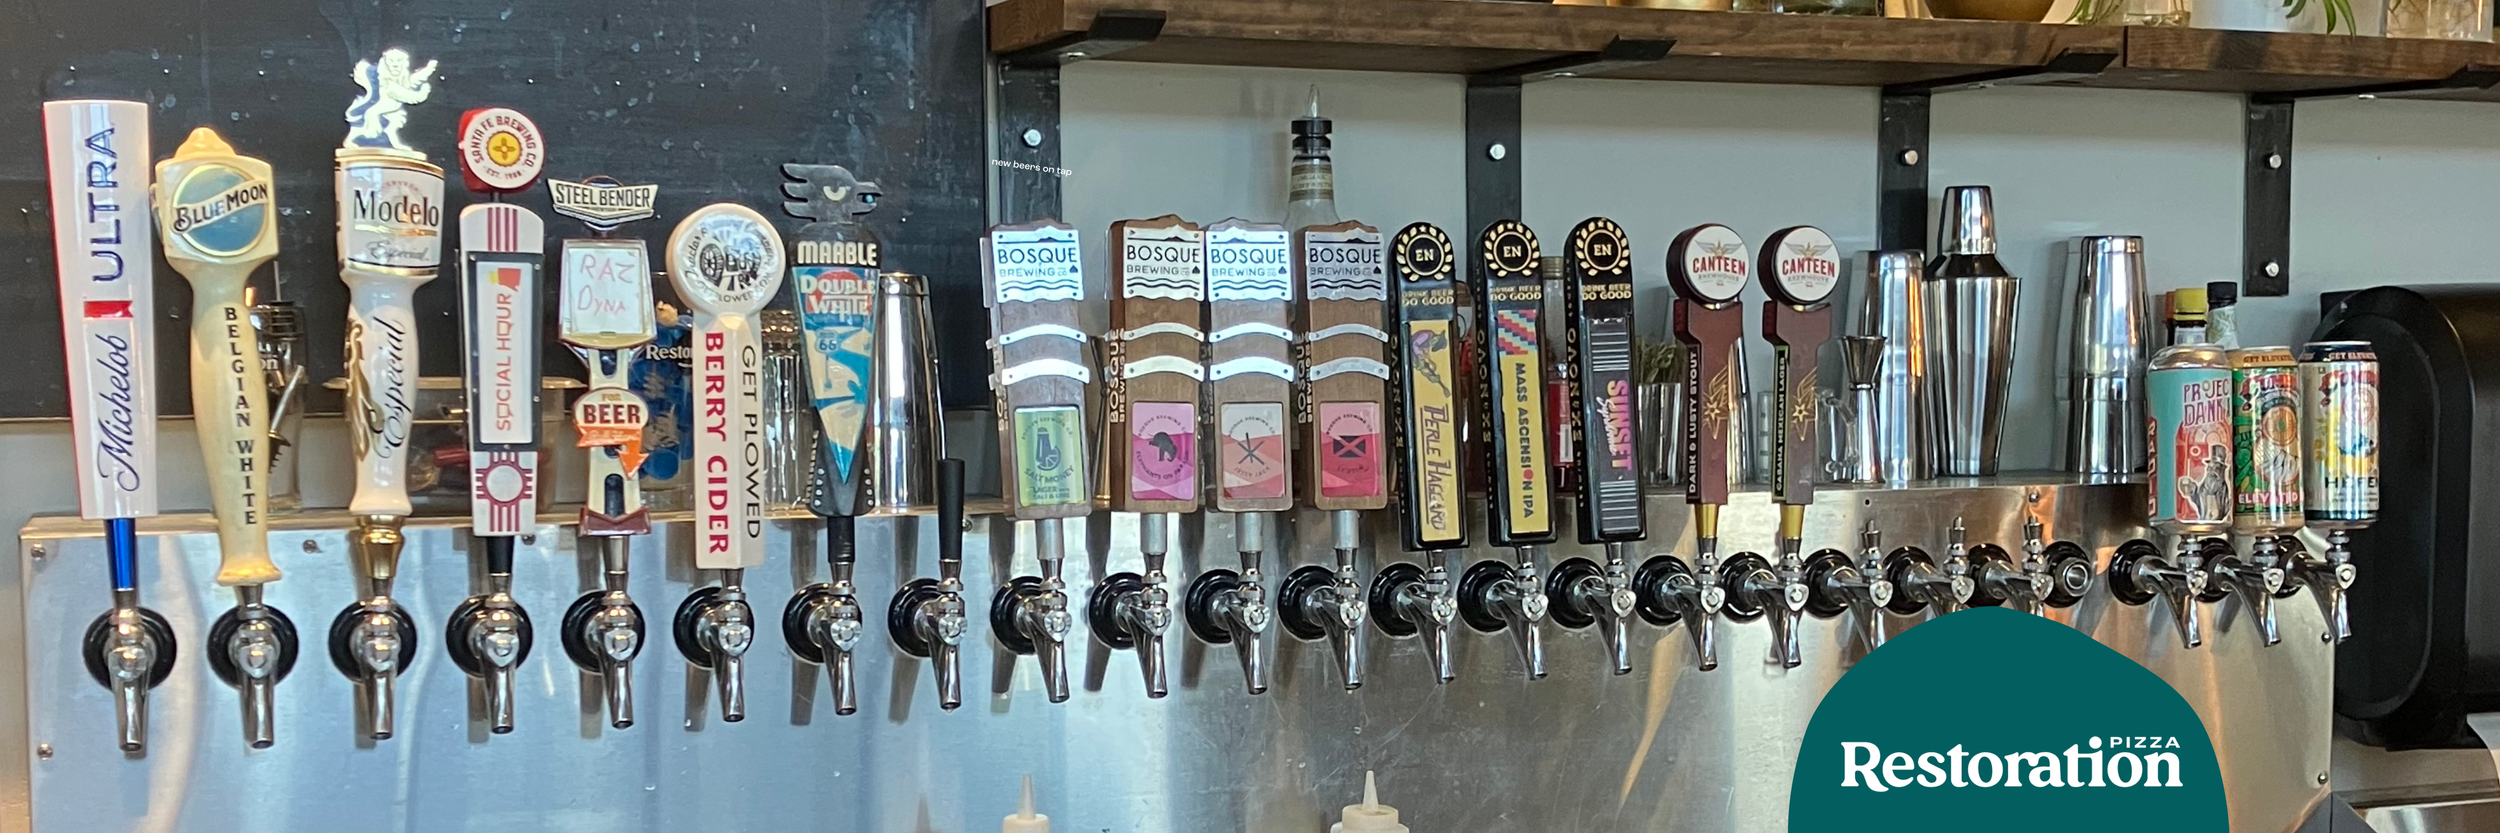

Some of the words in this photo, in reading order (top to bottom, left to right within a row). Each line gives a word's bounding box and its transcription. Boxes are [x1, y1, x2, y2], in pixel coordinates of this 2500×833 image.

[471, 129, 485, 163] SANTA
[480, 118, 495, 131] FE
[495, 115, 536, 149] BREWING
[84, 127, 125, 282] ULTRA
[174, 200, 226, 232] BLUE
[225, 183, 268, 212] MOON
[354, 189, 439, 227] Modelo
[556, 183, 597, 206] STEEL
[600, 187, 651, 208] BENDER
[797, 240, 877, 266] MARBLE
[998, 247, 1077, 264] BOSQUE
[1127, 245, 1200, 263] BOSQUE
[1211, 249, 1287, 265] BOSQUE
[1310, 248, 1381, 264] BOSQUE
[1415, 249, 1434, 262] EN
[1503, 246, 1522, 258] EN
[1593, 244, 1612, 256] EN
[580, 253, 635, 284] RAZ
[1000, 268, 1055, 278] BREWING
[1127, 265, 1179, 276] BREWING
[1212, 267, 1265, 277] BREWING
[1310, 267, 1361, 276] BREWING
[1693, 254, 1747, 277] CANTEEN
[1782, 256, 1836, 278] CANTEEN
[800, 274, 876, 295] DOUBLE
[1490, 293, 1506, 301] DO
[1509, 292, 1542, 300] GOOD
[1582, 292, 1597, 301] DO
[1600, 291, 1632, 300] GOOD
[808, 294, 871, 322] WHITE
[1402, 298, 1418, 307] DO
[1422, 296, 1454, 305] GOOD
[496, 293, 513, 350] HOUR
[645, 344, 692, 361] Resto
[819, 339, 837, 351] 66
[224, 307, 251, 428] BELGIAN
[742, 345, 757, 401] GET
[1109, 328, 1119, 423] BOSQUE
[1477, 329, 1489, 399] NOVO
[1567, 327, 1579, 397] NOVO
[1689, 352, 1697, 395] STOUT
[372, 316, 412, 459] Especial
[705, 332, 727, 442] BERRY
[1296, 332, 1306, 424] BOSQUE
[2184, 378, 2229, 403] PROJEC
[496, 356, 514, 431] SOCIAL
[95, 333, 140, 492] Michelob
[583, 404, 641, 425] BEER
[1607, 380, 1632, 470] SUNSET
[1688, 398, 1697, 439] LUSTY
[1424, 404, 1449, 458] PERLE
[1515, 363, 1528, 402] MASS
[1522, 495, 1534, 518] IPA
[235, 439, 257, 525] WHITE
[744, 413, 761, 538] PLOWED
[1024, 467, 1044, 483] SALT
[1045, 465, 1075, 483] MONEY
[1688, 457, 1697, 493] DARK
[707, 455, 729, 554] CIDER
